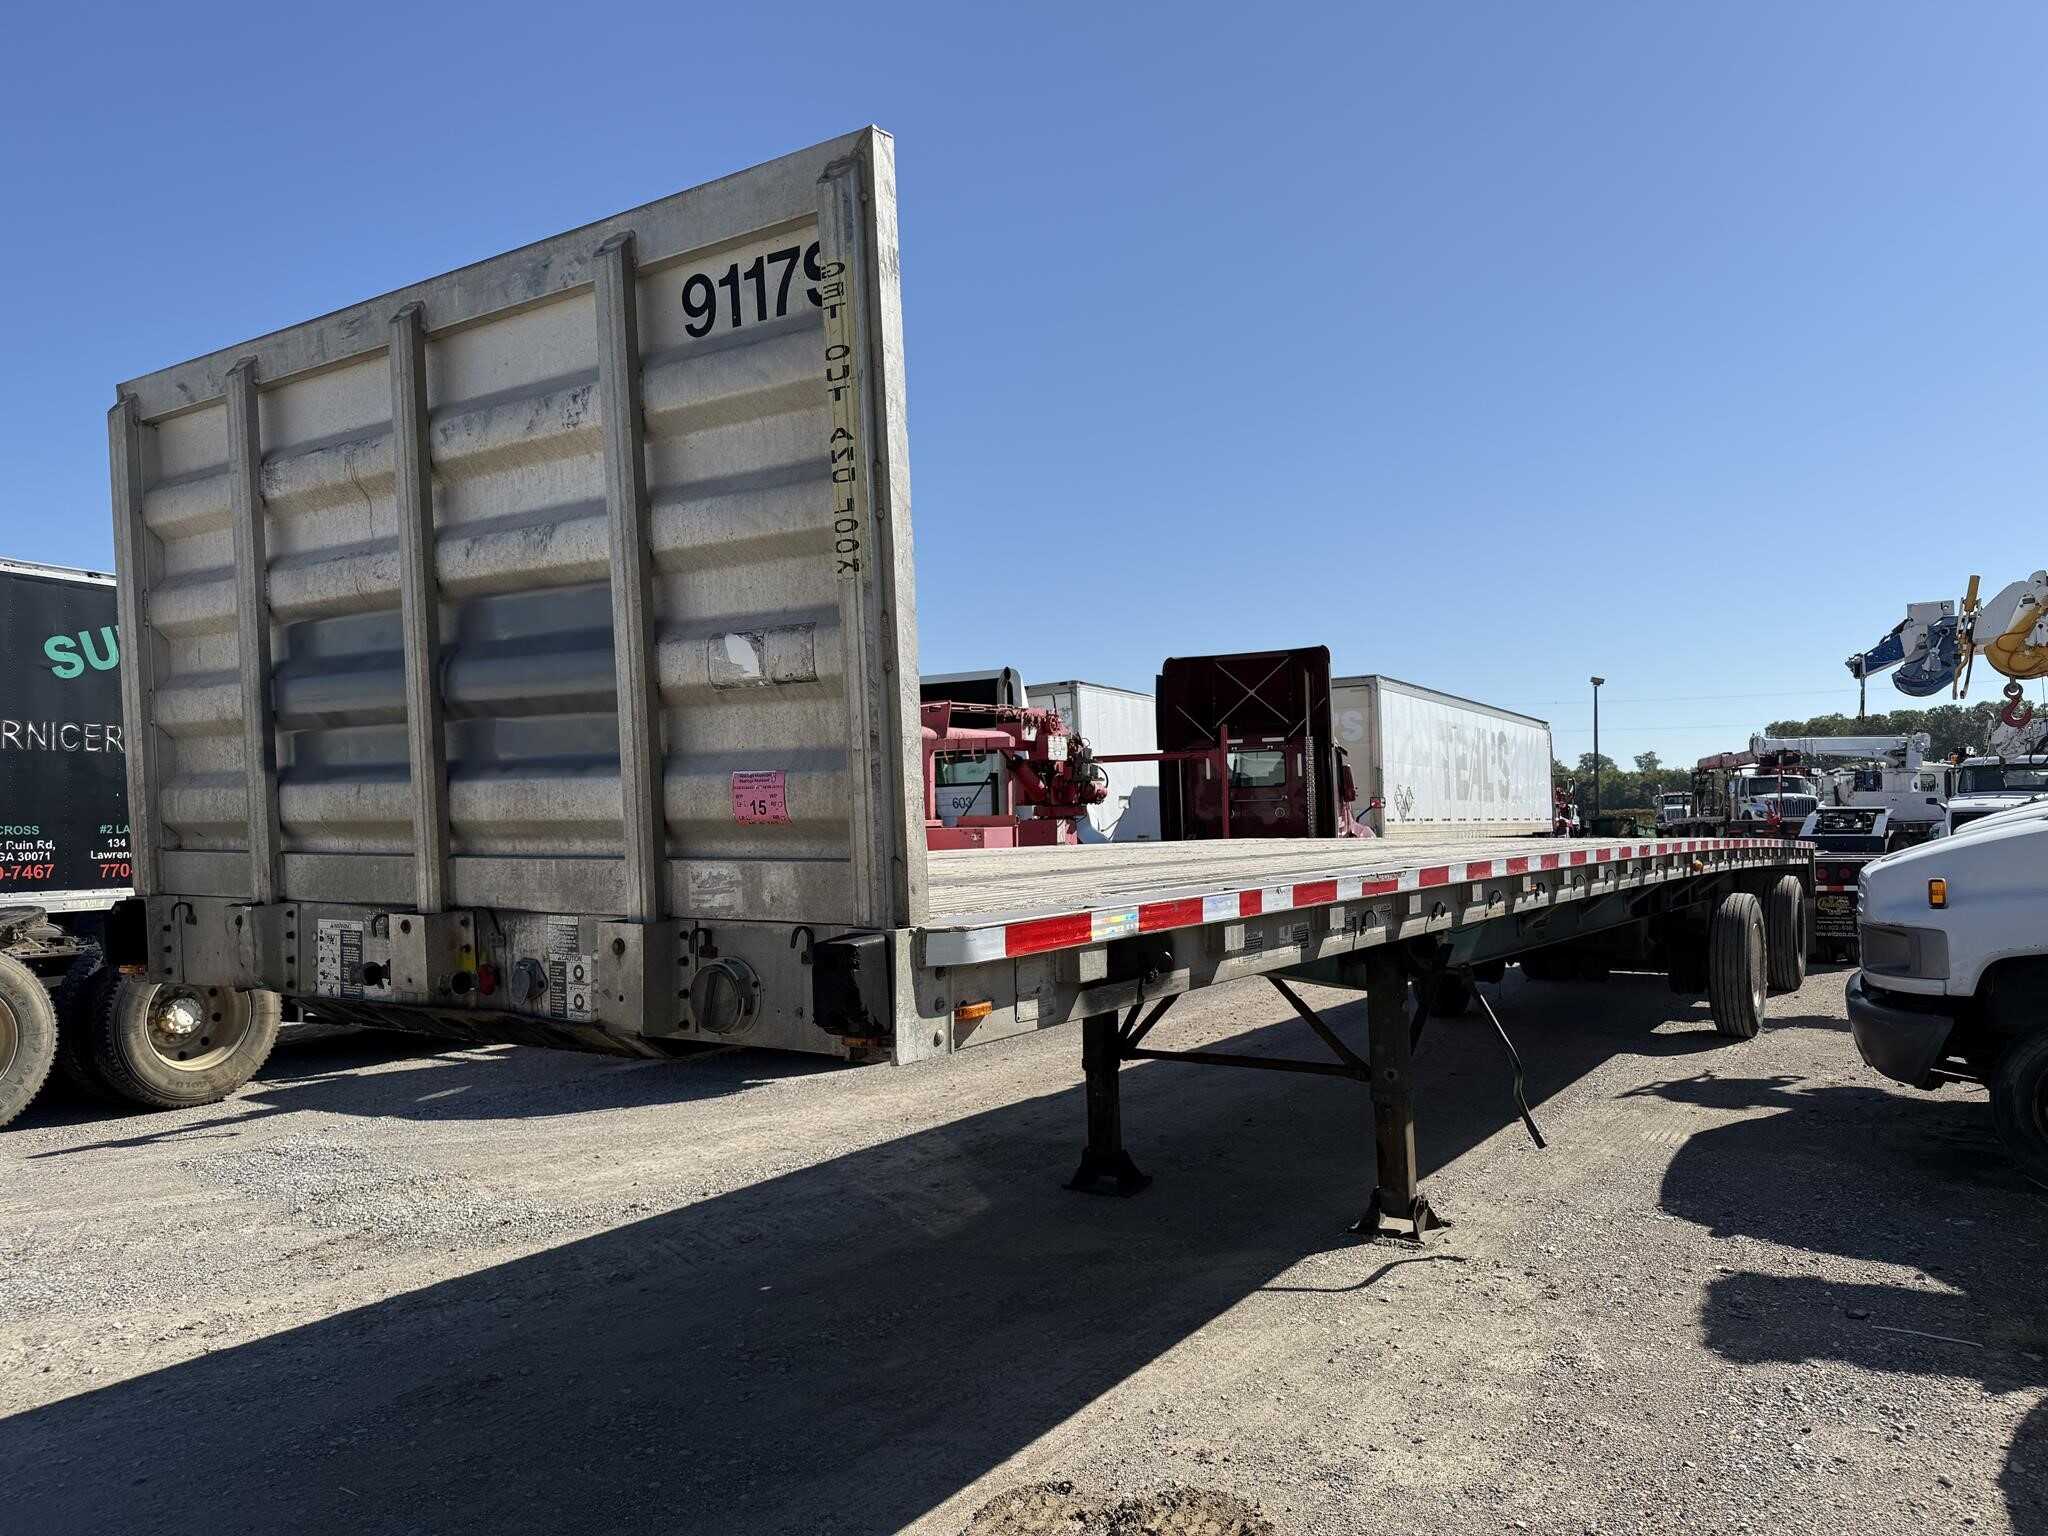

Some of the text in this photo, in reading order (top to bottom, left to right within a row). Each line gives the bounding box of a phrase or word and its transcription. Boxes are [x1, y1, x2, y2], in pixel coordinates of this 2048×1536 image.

[44, 624, 121, 680] SU
[749, 799, 767, 816] 15
[99, 824, 113, 834] #2
[36, 839, 56, 851] Rd,
[107, 838, 126, 848] 134
[17, 851, 51, 861] 30071
